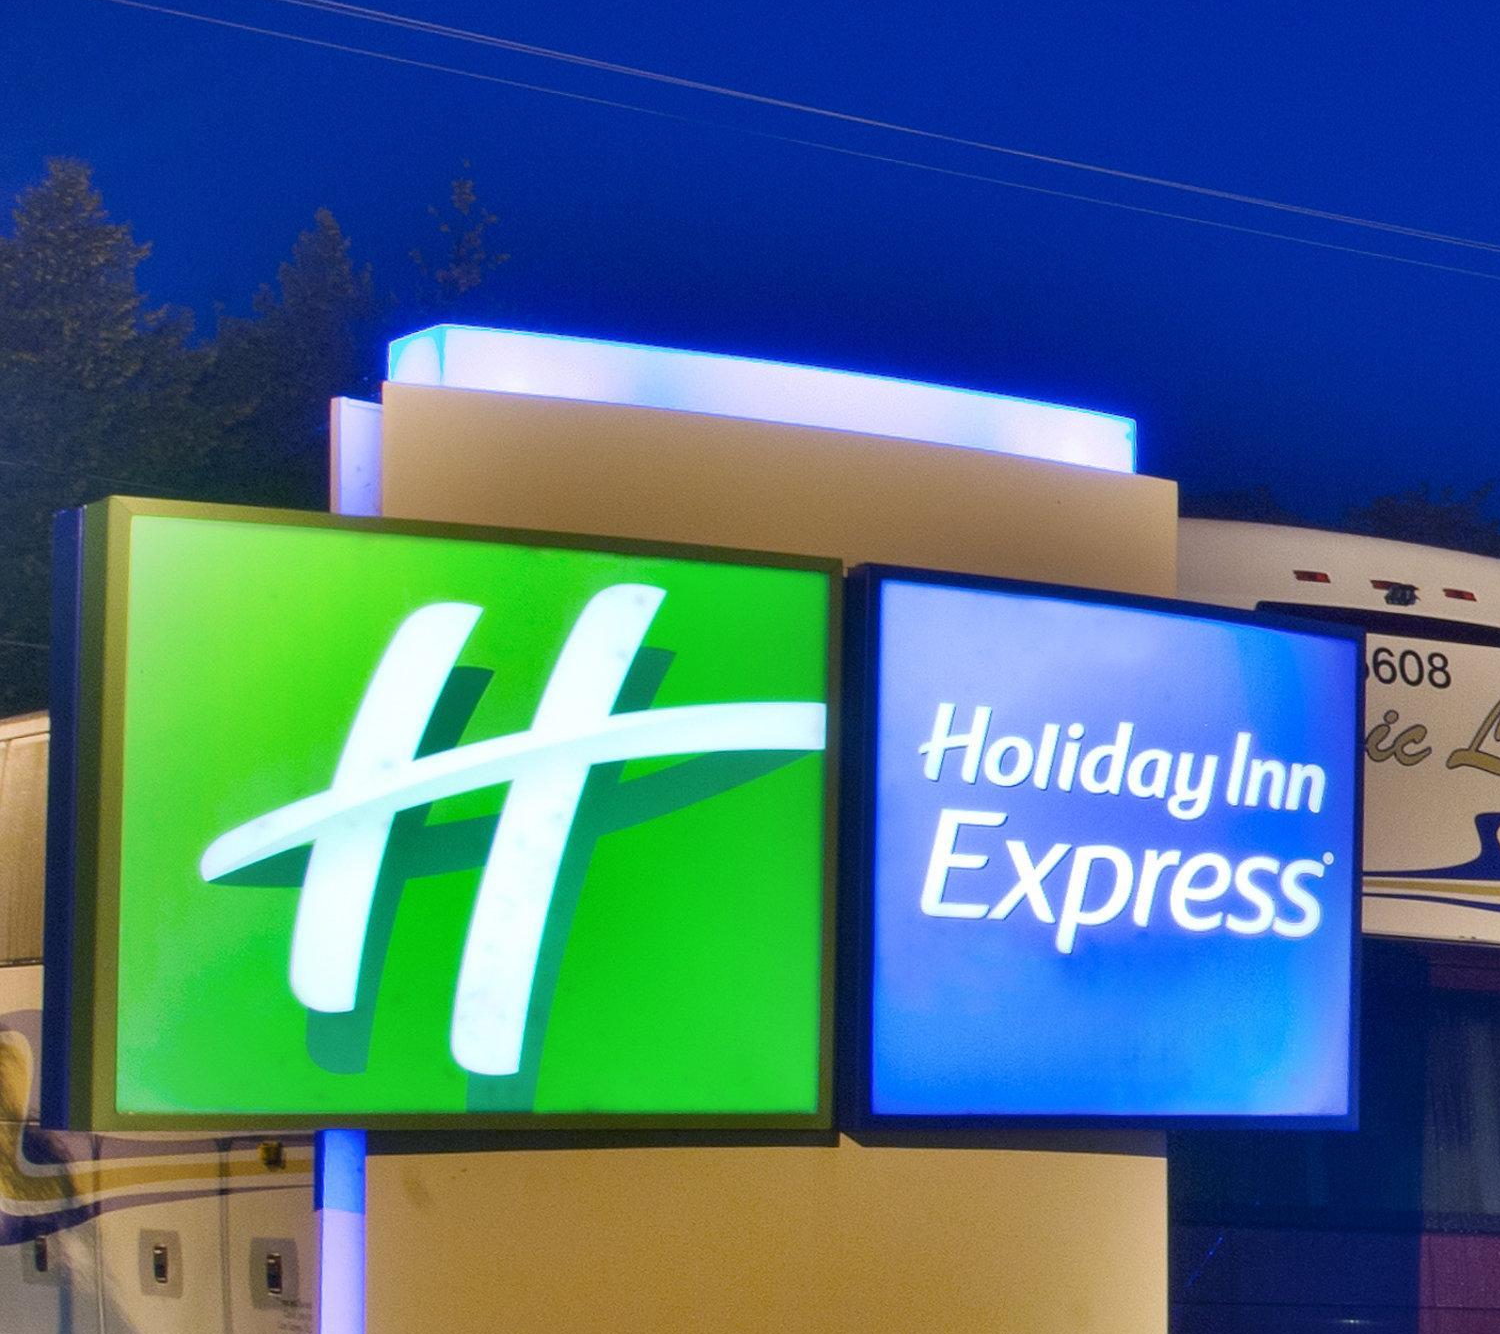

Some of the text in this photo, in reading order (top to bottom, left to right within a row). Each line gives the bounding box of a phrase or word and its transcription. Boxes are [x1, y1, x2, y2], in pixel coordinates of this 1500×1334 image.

[1366, 647, 1452, 689] 608
[918, 702, 1328, 820] Holiday Inn
[1366, 709, 1432, 767] ic
